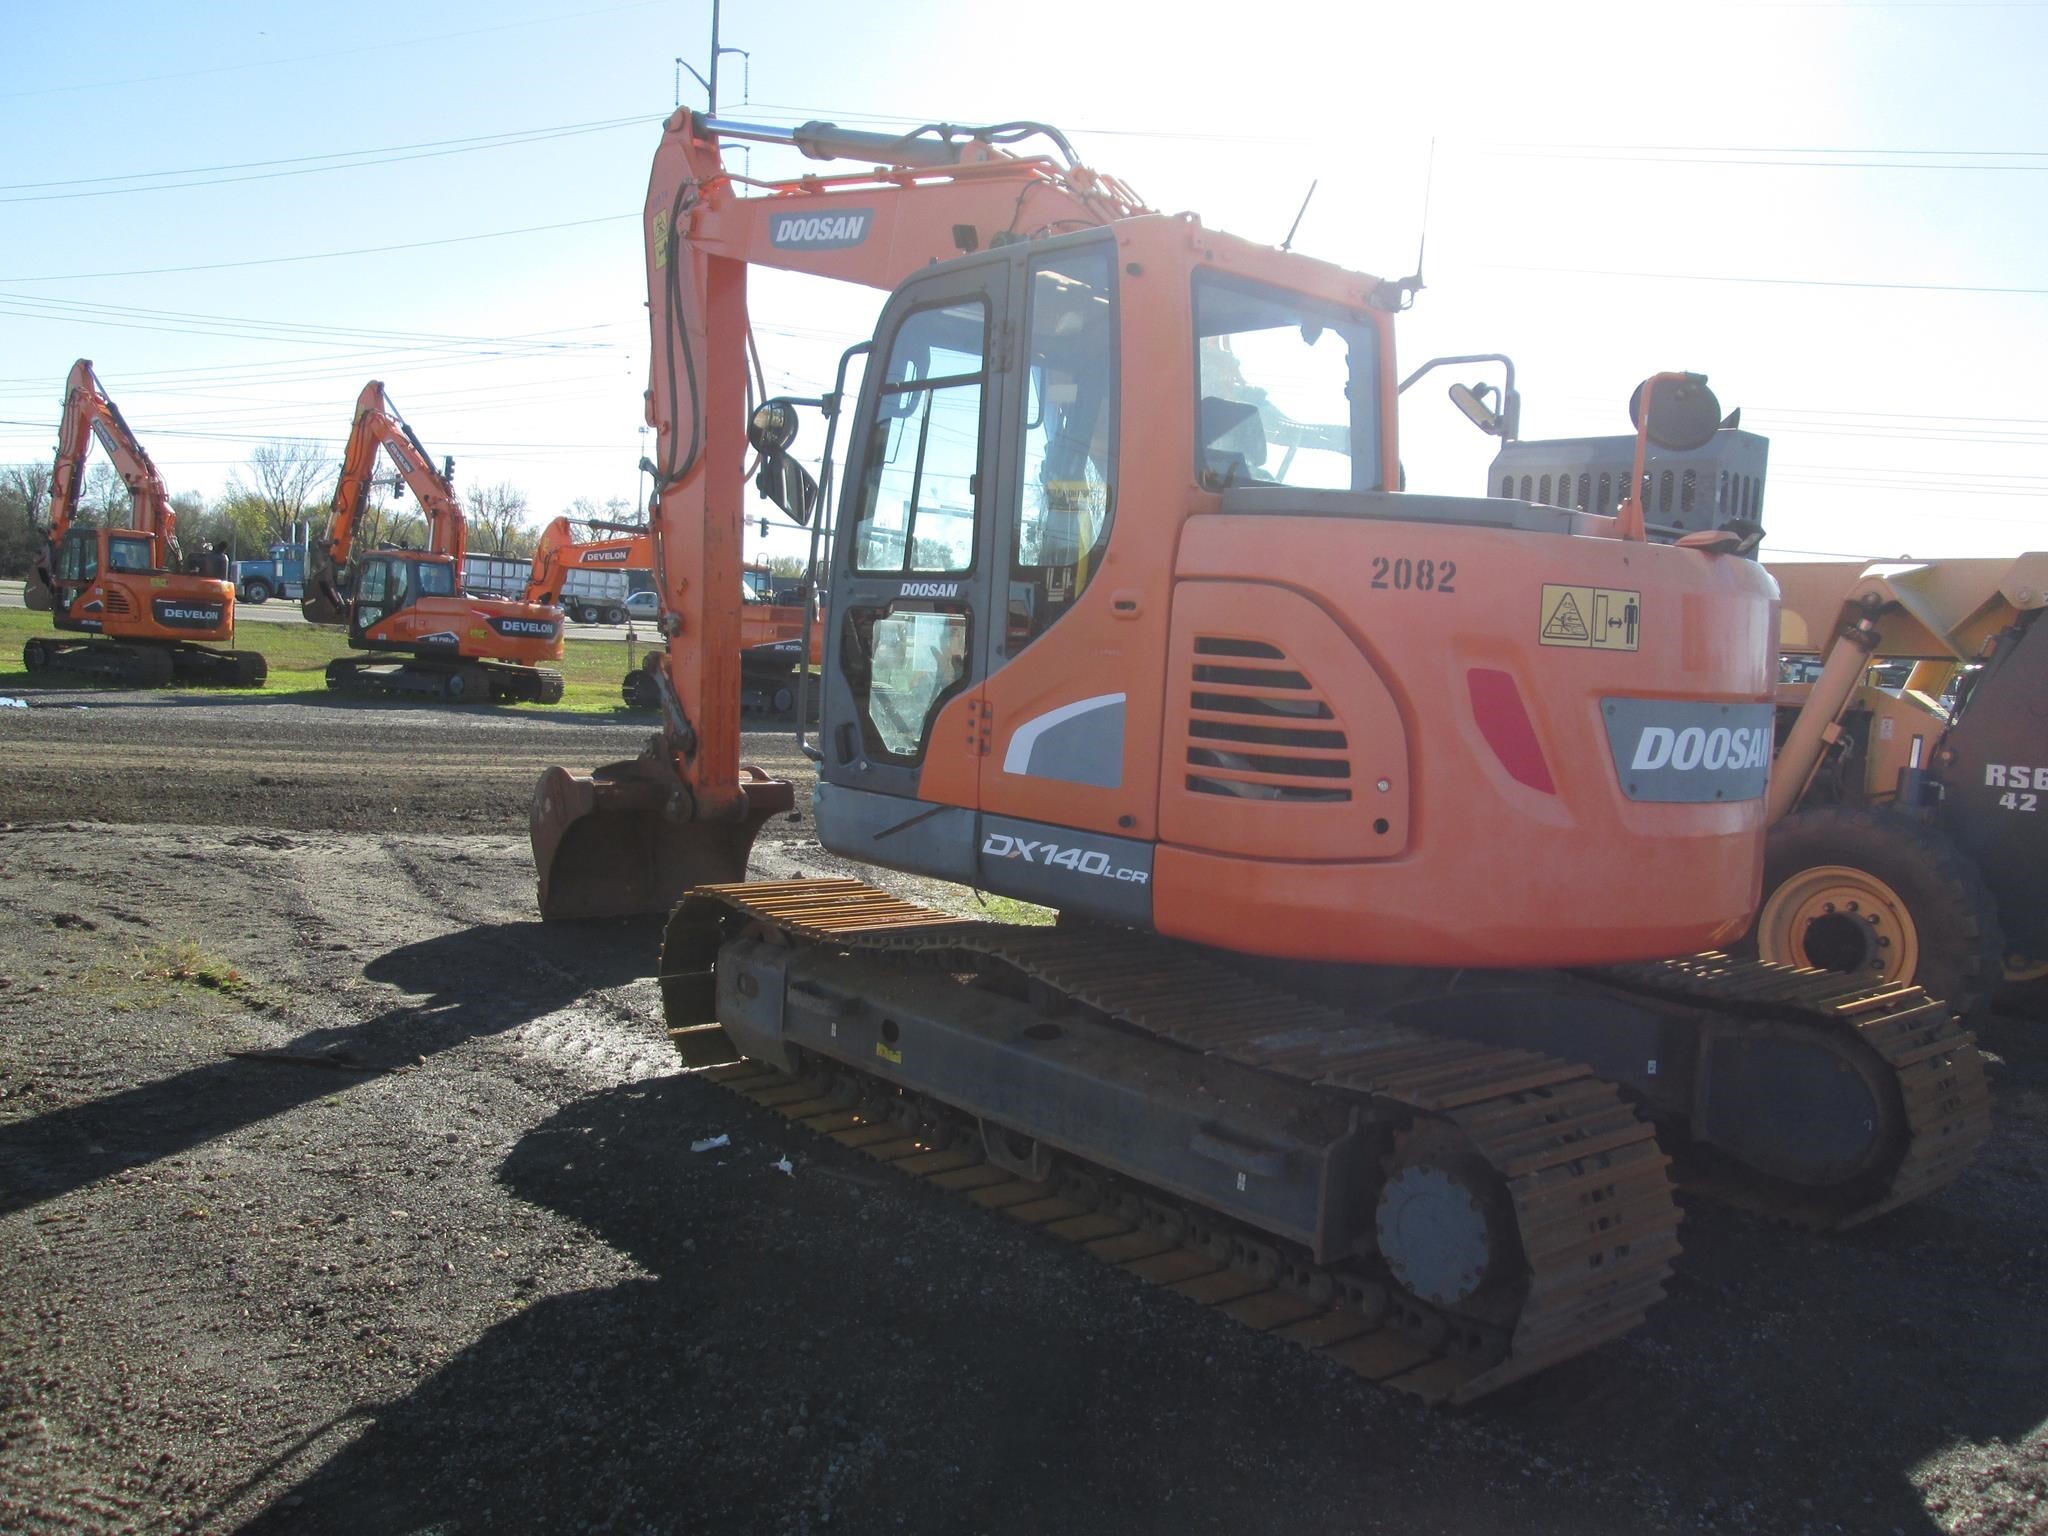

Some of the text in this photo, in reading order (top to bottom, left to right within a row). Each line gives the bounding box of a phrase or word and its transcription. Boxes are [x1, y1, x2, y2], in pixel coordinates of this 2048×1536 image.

[775, 216, 864, 243] DOOSAN
[587, 552, 626, 561] DEVELON
[1372, 558, 1456, 592] 2082
[900, 583, 957, 598] DOOSAN
[165, 608, 218, 620] DEVELON
[503, 621, 553, 633] DEVELON
[2000, 793, 2037, 812] 42
